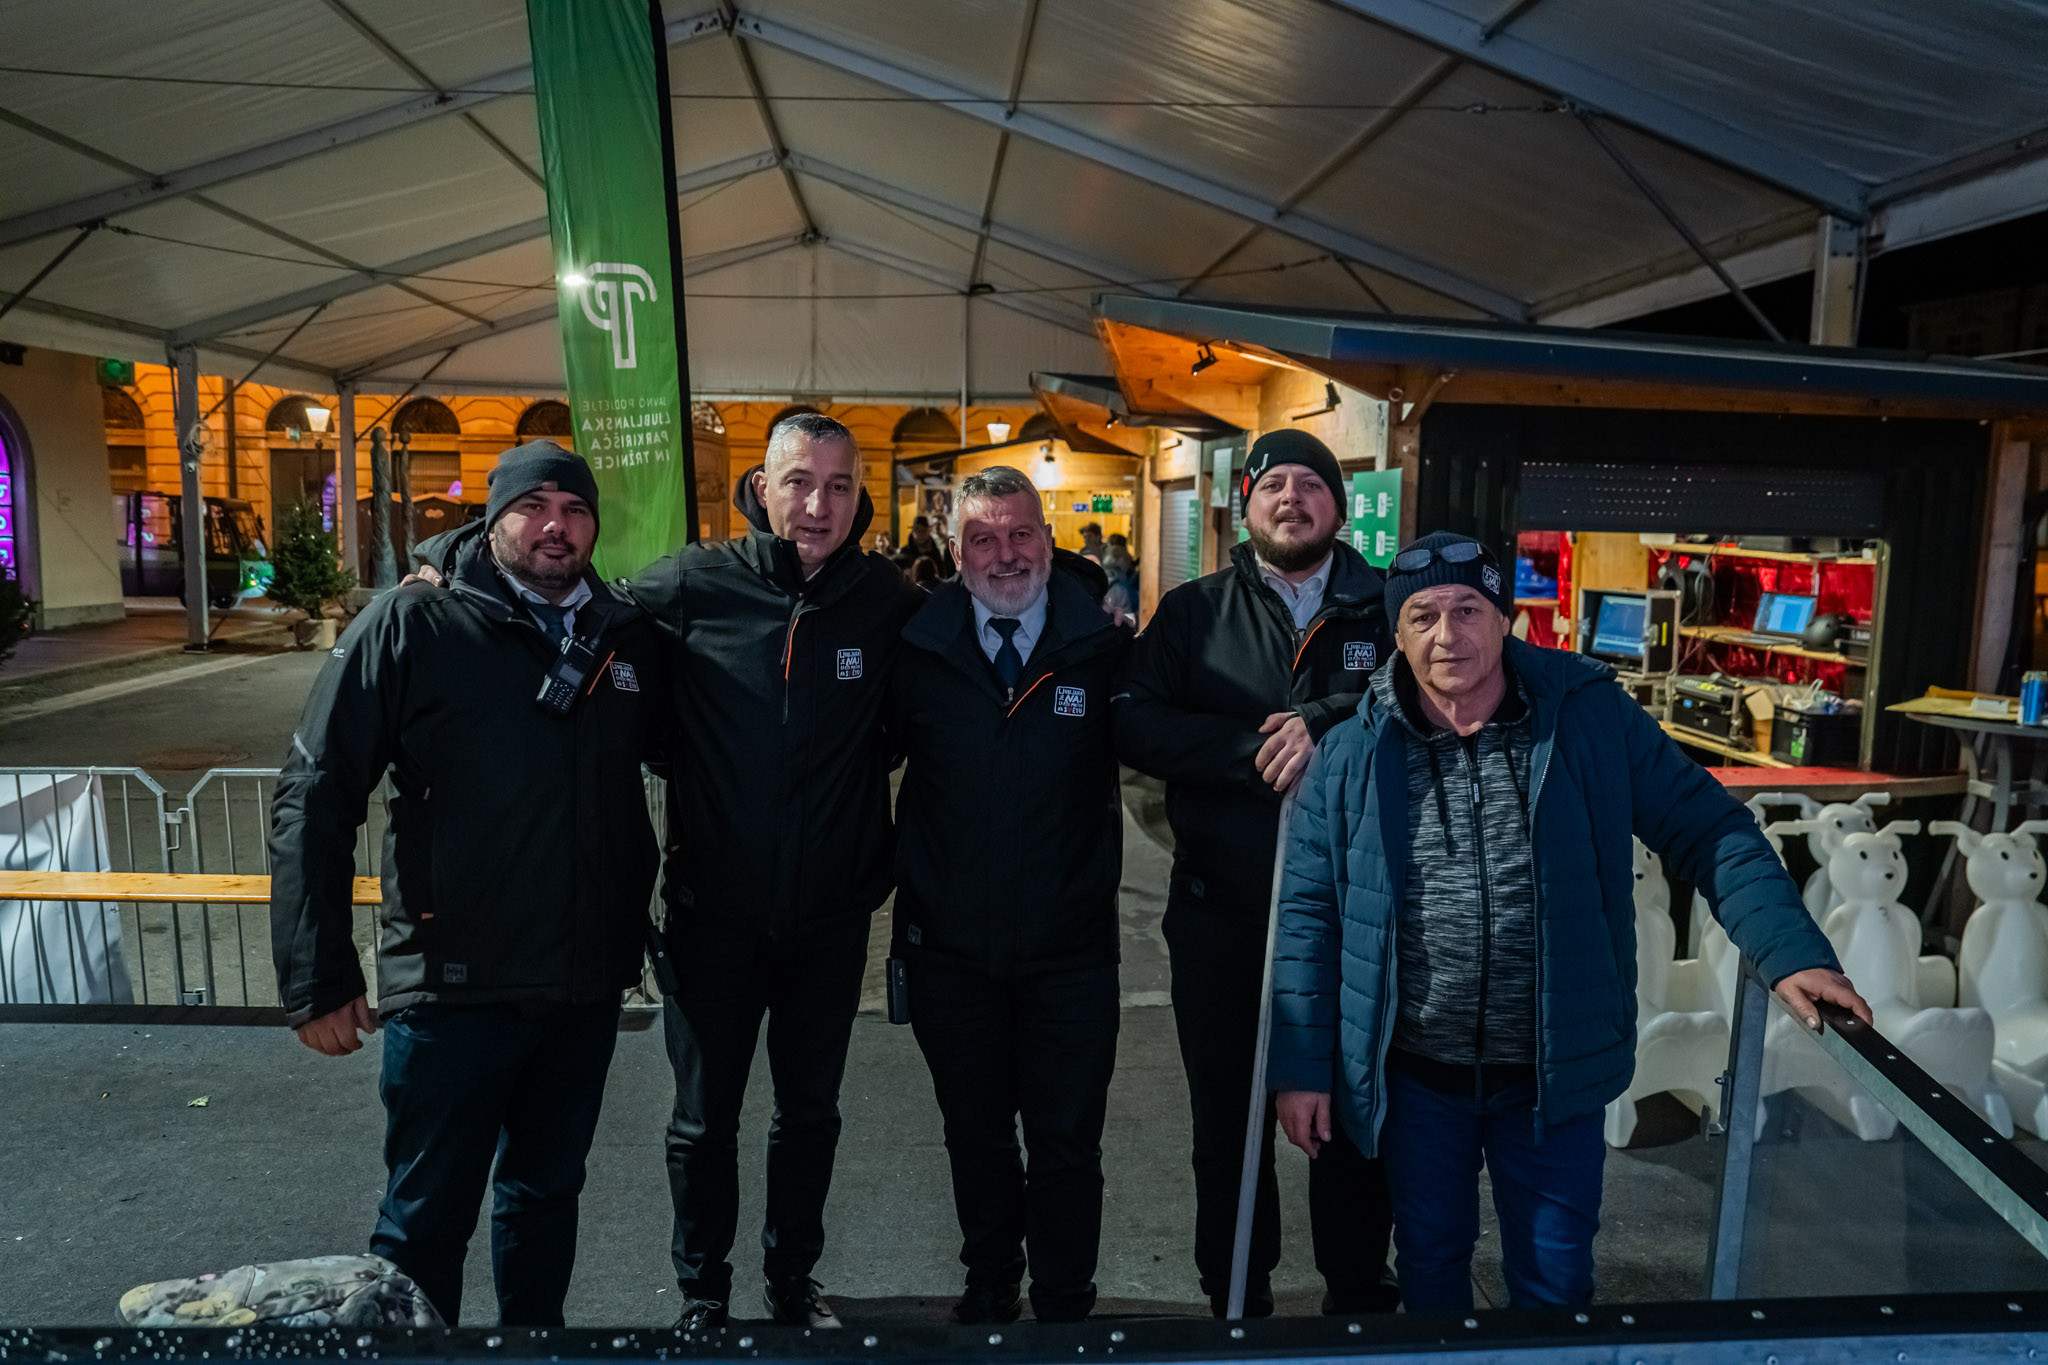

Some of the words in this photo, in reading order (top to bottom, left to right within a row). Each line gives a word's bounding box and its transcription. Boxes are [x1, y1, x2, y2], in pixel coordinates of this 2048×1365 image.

[1354, 649, 1373, 658] NAJ
[846, 656, 860, 666] NAJ
[1064, 694, 1082, 704] NAJ
